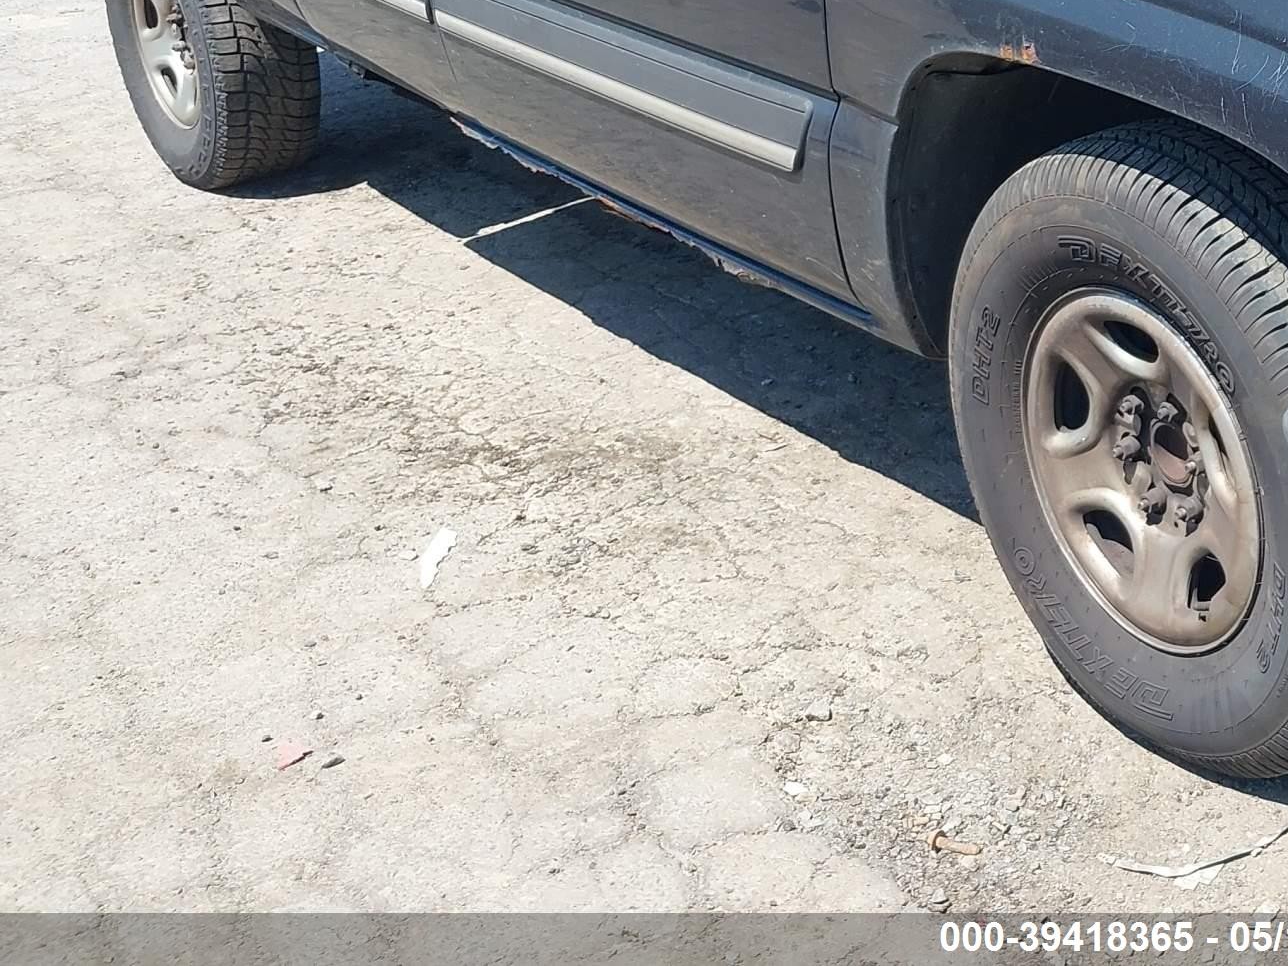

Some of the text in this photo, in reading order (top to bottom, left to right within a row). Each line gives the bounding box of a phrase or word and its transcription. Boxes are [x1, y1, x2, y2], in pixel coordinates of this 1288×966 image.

[971, 304, 1001, 406] DHT2
[1056, 234, 1236, 396] DEXTERO
[1013, 545, 1175, 722] DEXTERO
[1256, 561, 1287, 674] DHT2
